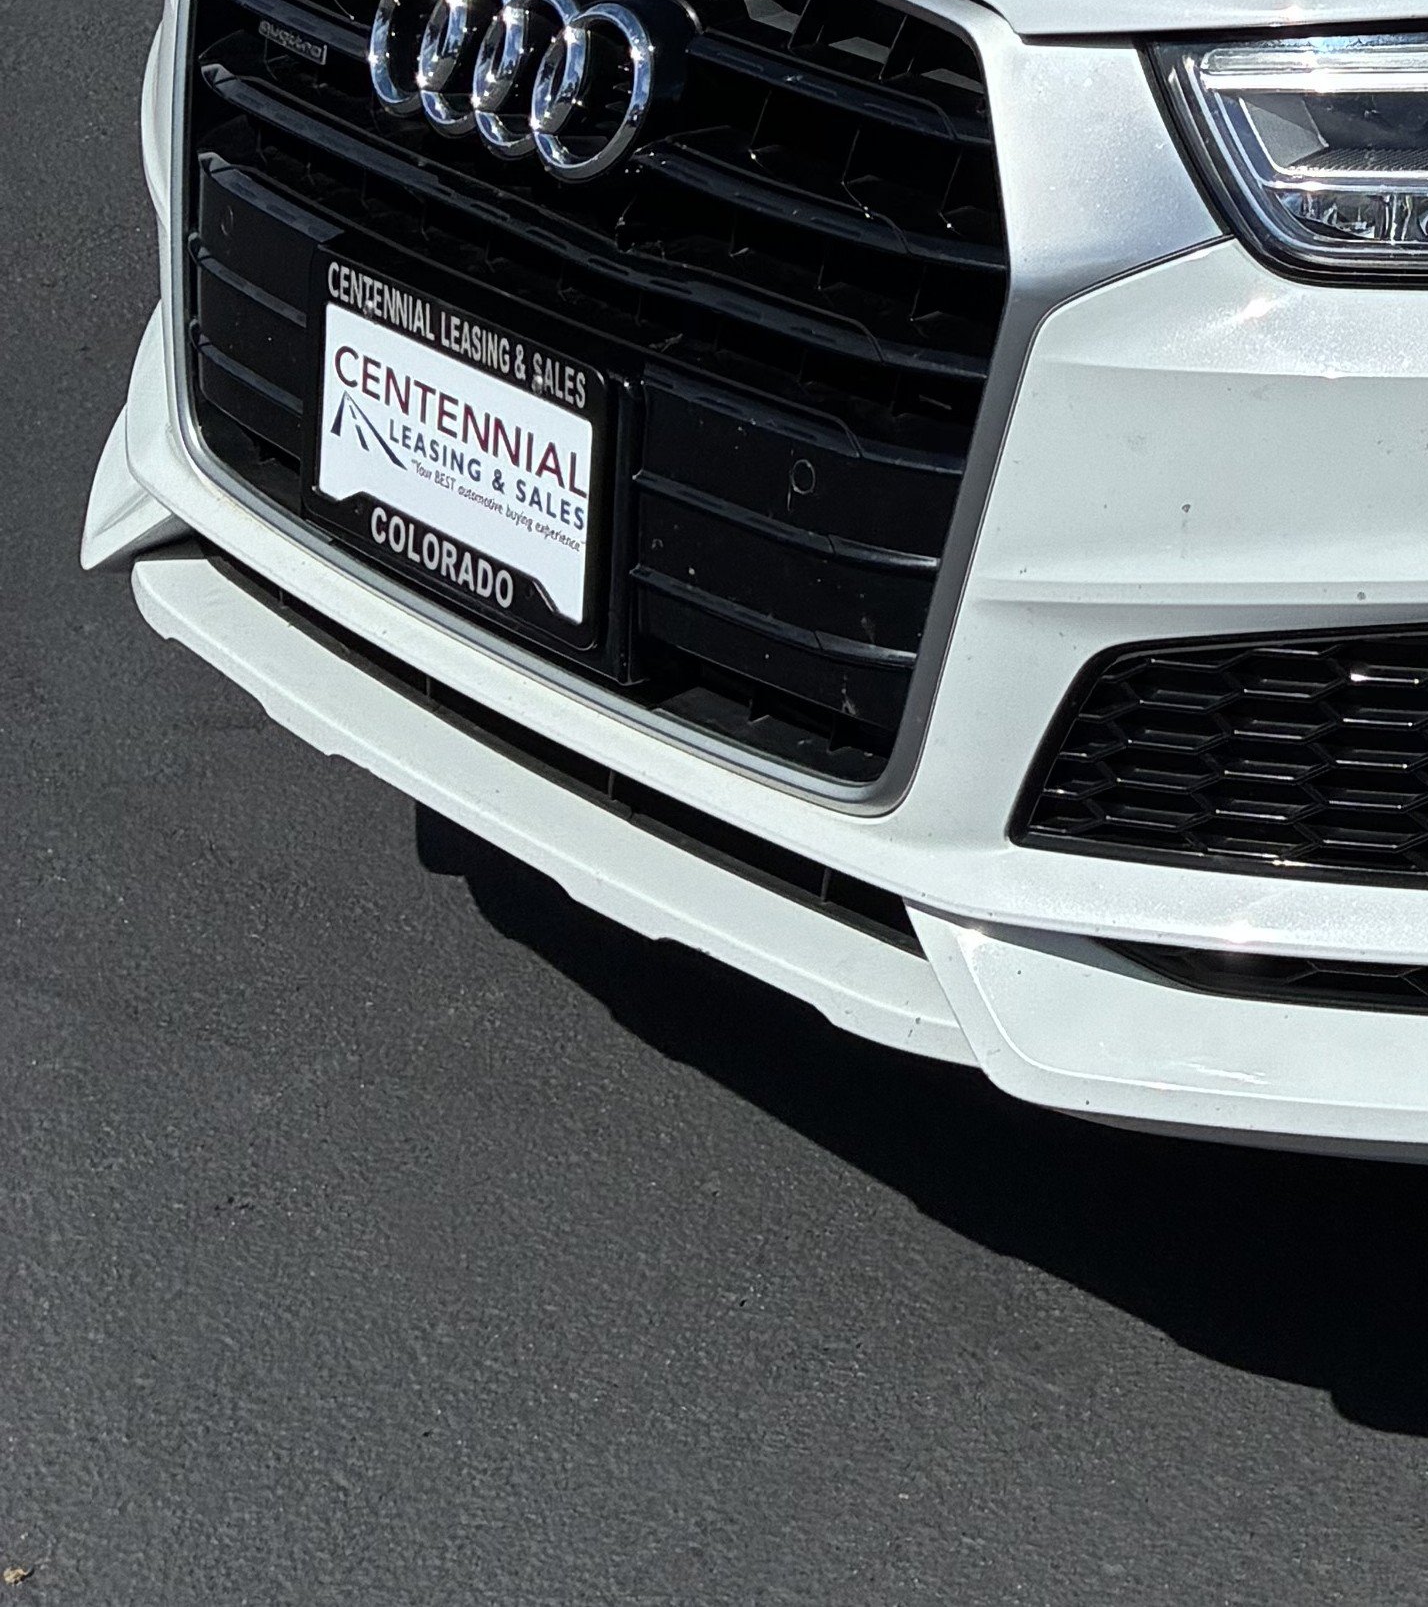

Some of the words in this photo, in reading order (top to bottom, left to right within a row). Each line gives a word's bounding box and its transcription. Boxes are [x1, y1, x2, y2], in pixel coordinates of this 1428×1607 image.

[327, 261, 435, 340] CENTENNIAL
[441, 311, 510, 374] LEASING
[514, 344, 526, 381] &
[532, 352, 586, 408] SALES
[334, 345, 588, 499] CENTENNIAL
[389, 419, 481, 482] LEASING
[492, 469, 505, 494] &
[516, 479, 585, 531] SALES
[434, 470, 457, 492] BEST
[506, 504, 533, 532] buying
[371, 507, 514, 608] COLORADO
